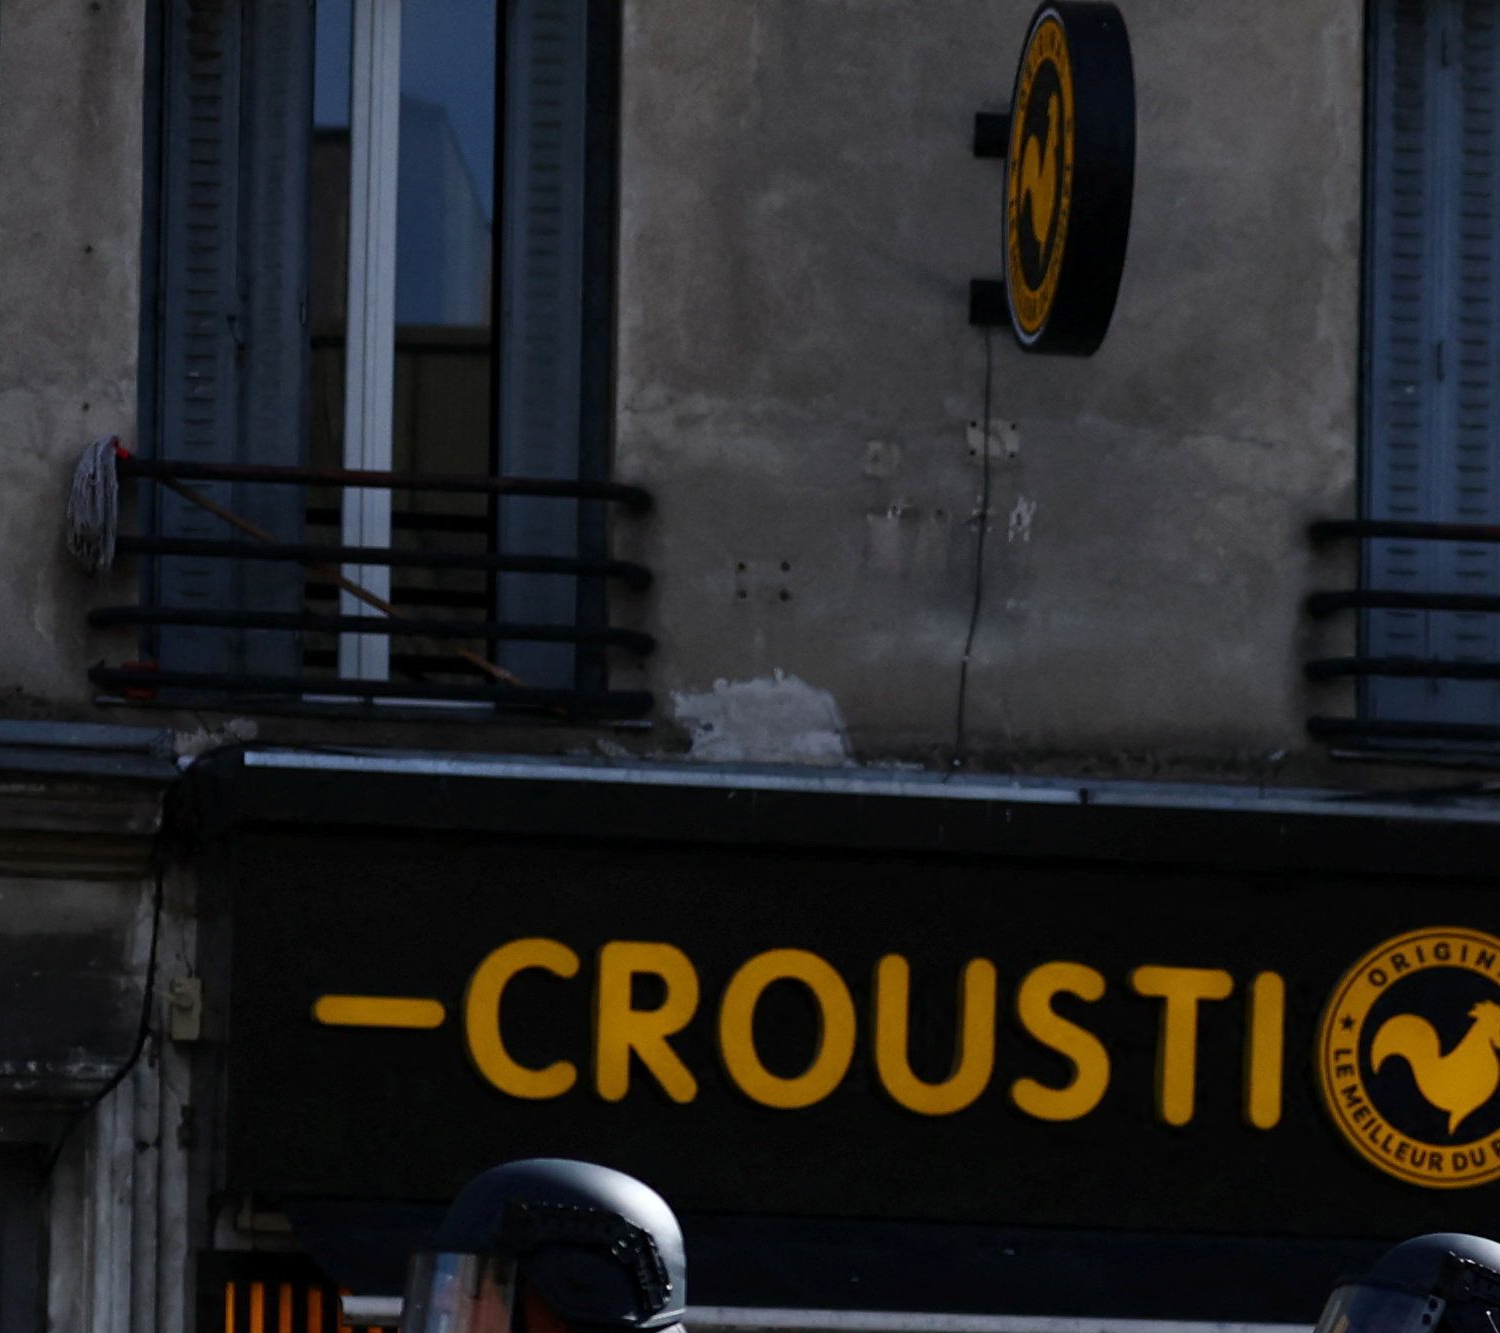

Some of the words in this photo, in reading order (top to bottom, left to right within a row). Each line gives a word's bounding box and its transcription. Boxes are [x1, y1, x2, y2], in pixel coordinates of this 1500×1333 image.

[463, 936, 1287, 1131] CROUSTI
[1334, 1047, 1355, 1079] LE
[1341, 1084, 1445, 1172] MEILLEUR
[1451, 1147, 1486, 1172] DU
